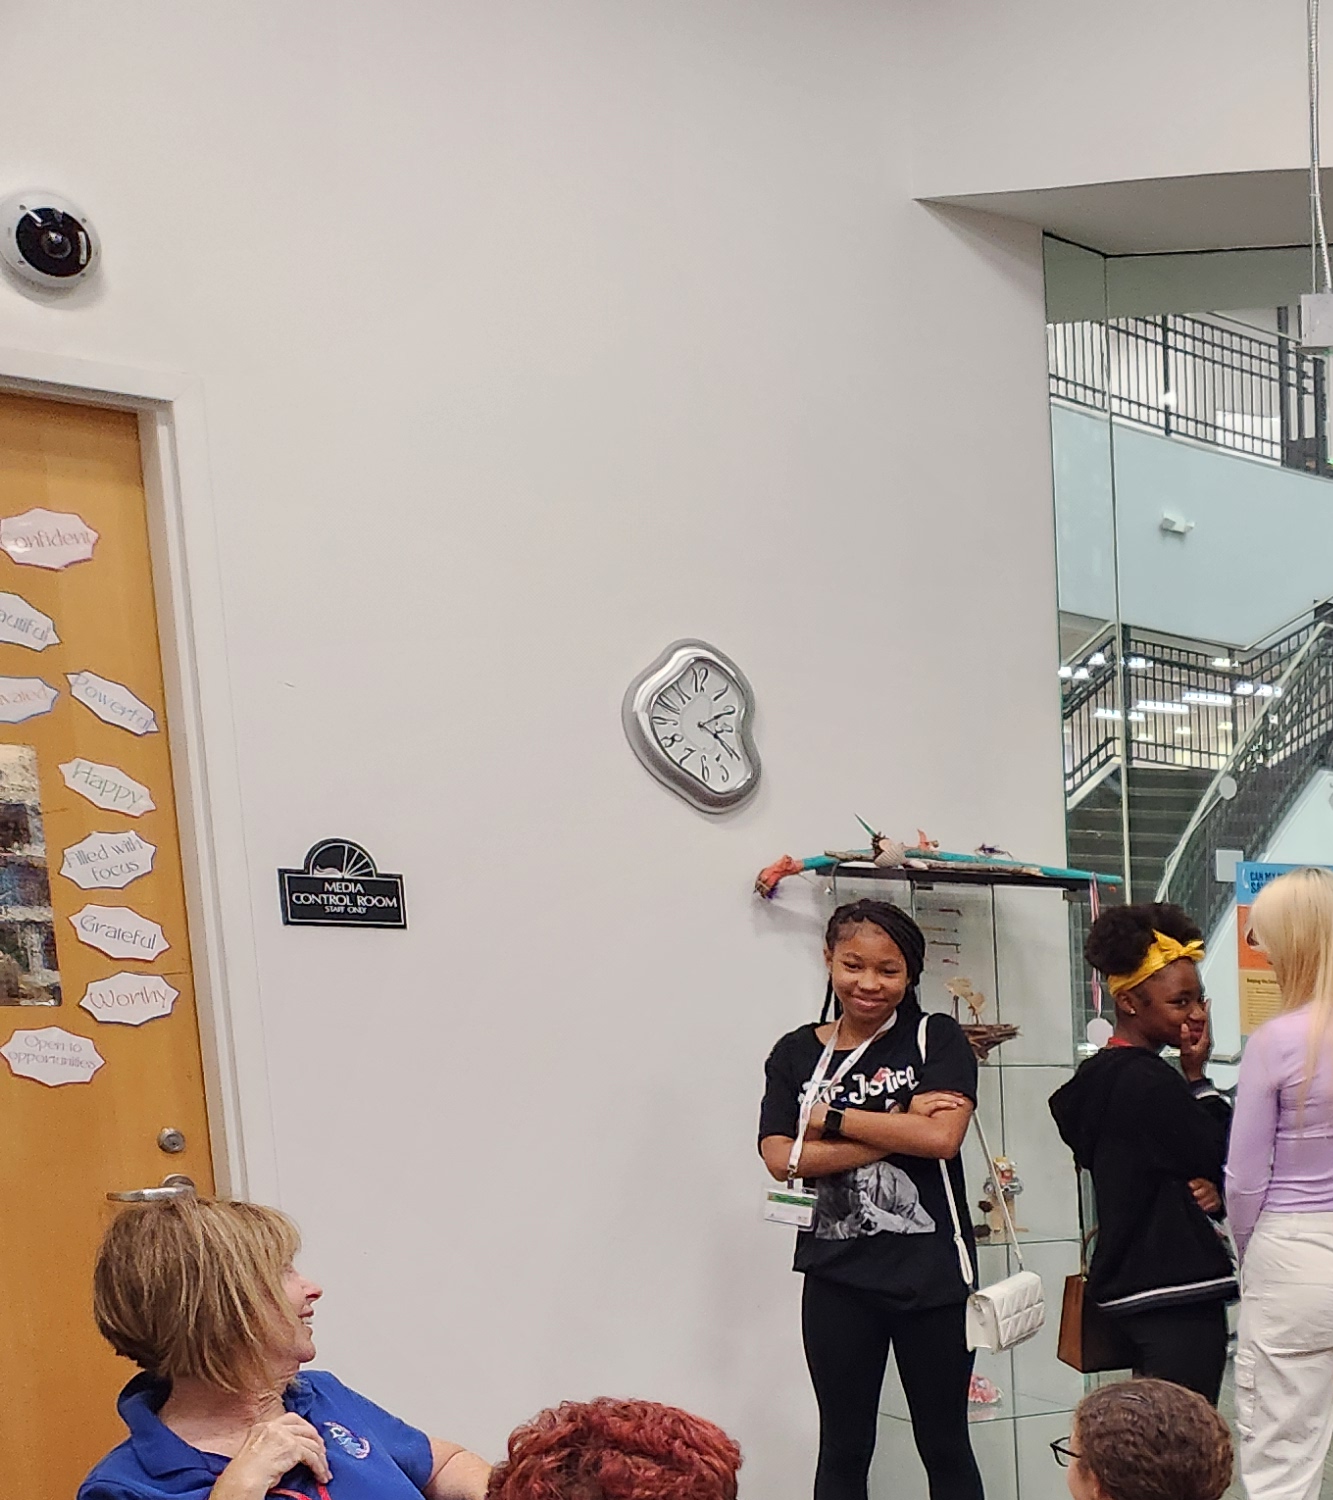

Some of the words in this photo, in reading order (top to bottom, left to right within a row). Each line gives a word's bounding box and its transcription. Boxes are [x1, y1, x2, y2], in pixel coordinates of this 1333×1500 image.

[72, 762, 143, 810] Happy
[65, 844, 109, 868] Filled
[111, 836, 143, 856] with
[324, 881, 365, 893] MEDIA
[292, 893, 353, 906] CONTROL
[358, 896, 398, 908] ROOM
[325, 905, 345, 913] STAFF
[80, 914, 157, 949] Grateful
[89, 986, 168, 1008] Worthy
[24, 1035, 65, 1051] Open
